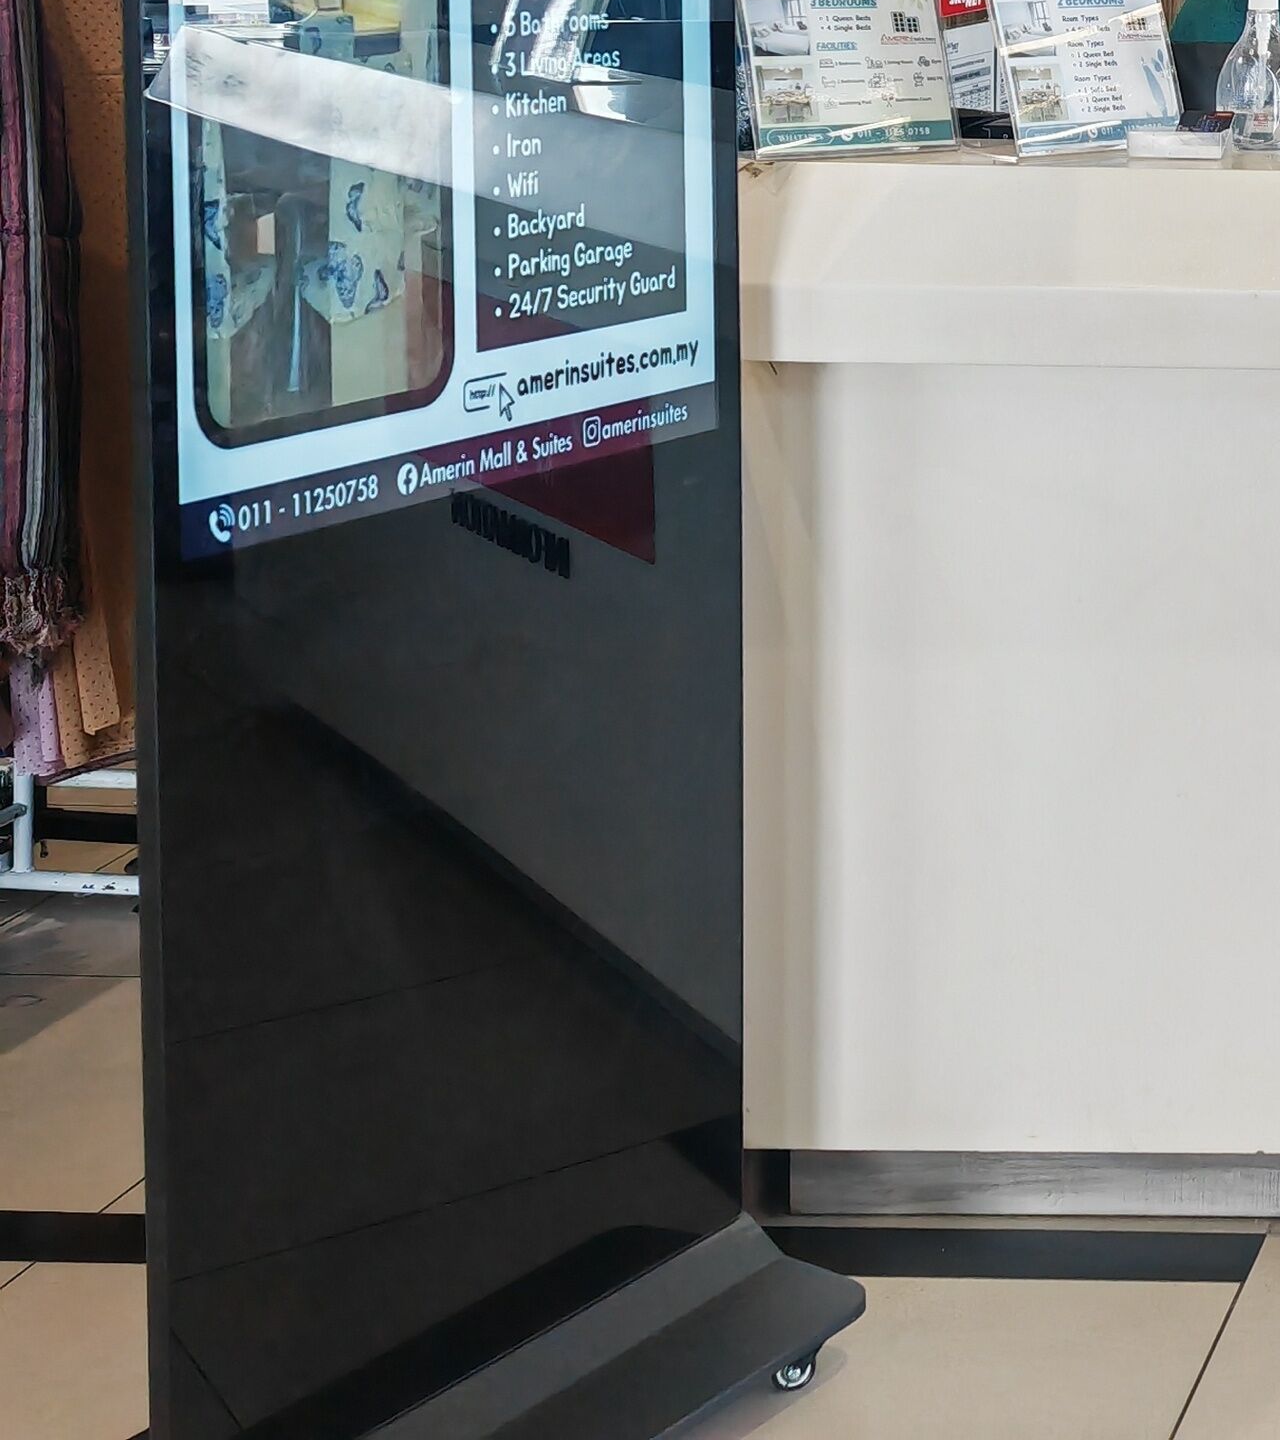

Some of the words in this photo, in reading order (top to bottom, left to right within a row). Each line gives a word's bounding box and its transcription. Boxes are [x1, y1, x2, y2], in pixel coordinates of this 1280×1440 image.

[520, 11, 609, 36] Barooms
[1062, 15, 1080, 23] Room
[1081, 15, 1099, 23] Types
[1083, 51, 1102, 59] Queen
[1085, 40, 1104, 49] Types
[505, 52, 516, 77] 3
[518, 49, 568, 81] Living
[574, 47, 620, 71] Areas
[1085, 60, 1104, 69] Single
[1093, 74, 1112, 83] Types
[505, 91, 567, 119] Kitchen
[1091, 97, 1110, 105] Queen
[1093, 105, 1112, 114] Single
[1113, 104, 1126, 112] Beds
[506, 134, 542, 159] Iron
[507, 170, 539, 198] Wifi
[507, 203, 585, 240] Backyard
[508, 247, 571, 281] Parking
[574, 240, 633, 270] Garage
[509, 287, 553, 319] 24/7
[557, 274, 626, 310] Security
[629, 265, 677, 296] Guard
[516, 337, 700, 398] amerinsuites.com.my
[237, 503, 272, 533] 011
[292, 474, 380, 519] 11250758
[418, 456, 476, 488] Amerin
[479, 442, 513, 472] Mall
[515, 441, 528, 464] &
[532, 431, 574, 460] Suites
[602, 402, 689, 441] amerinsuites
